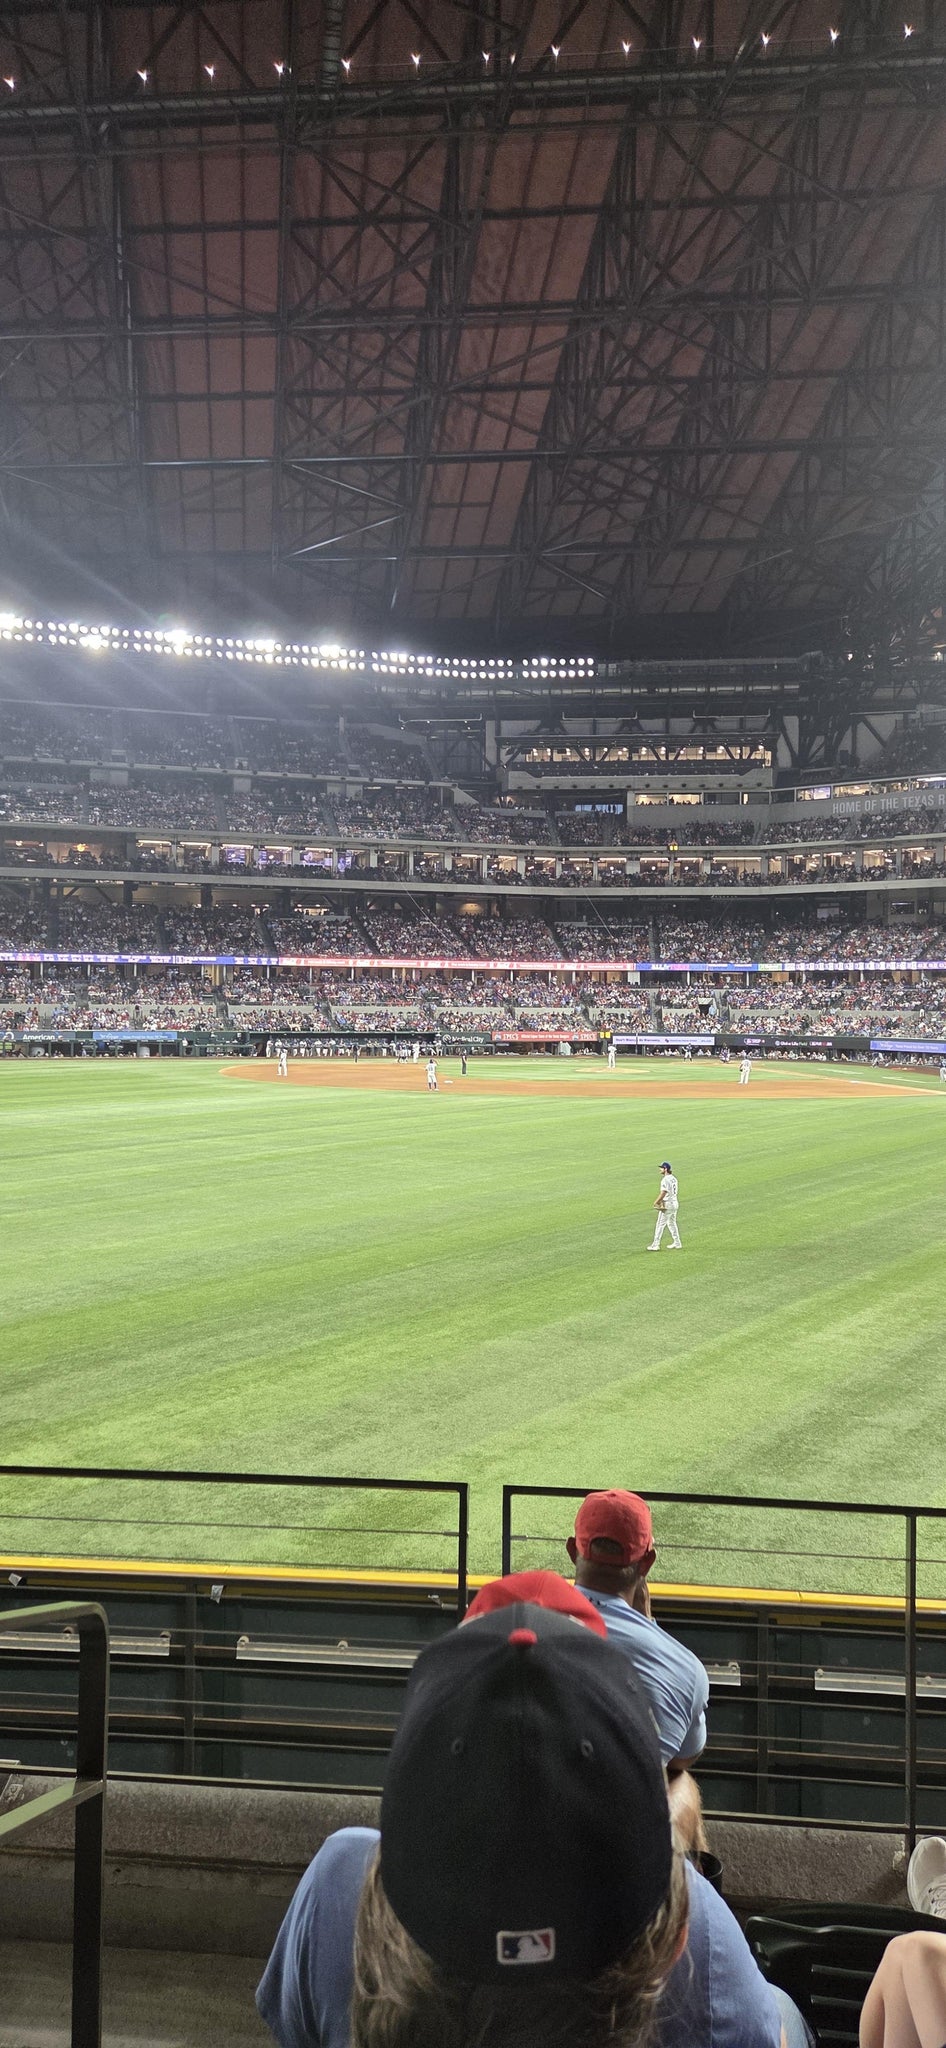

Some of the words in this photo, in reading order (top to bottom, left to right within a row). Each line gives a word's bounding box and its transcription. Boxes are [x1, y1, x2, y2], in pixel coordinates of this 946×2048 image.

[832, 801, 860, 814] HOME
[864, 800, 877, 812] OF
[881, 798, 899, 810] THE
[902, 794, 934, 809] TEXAS
